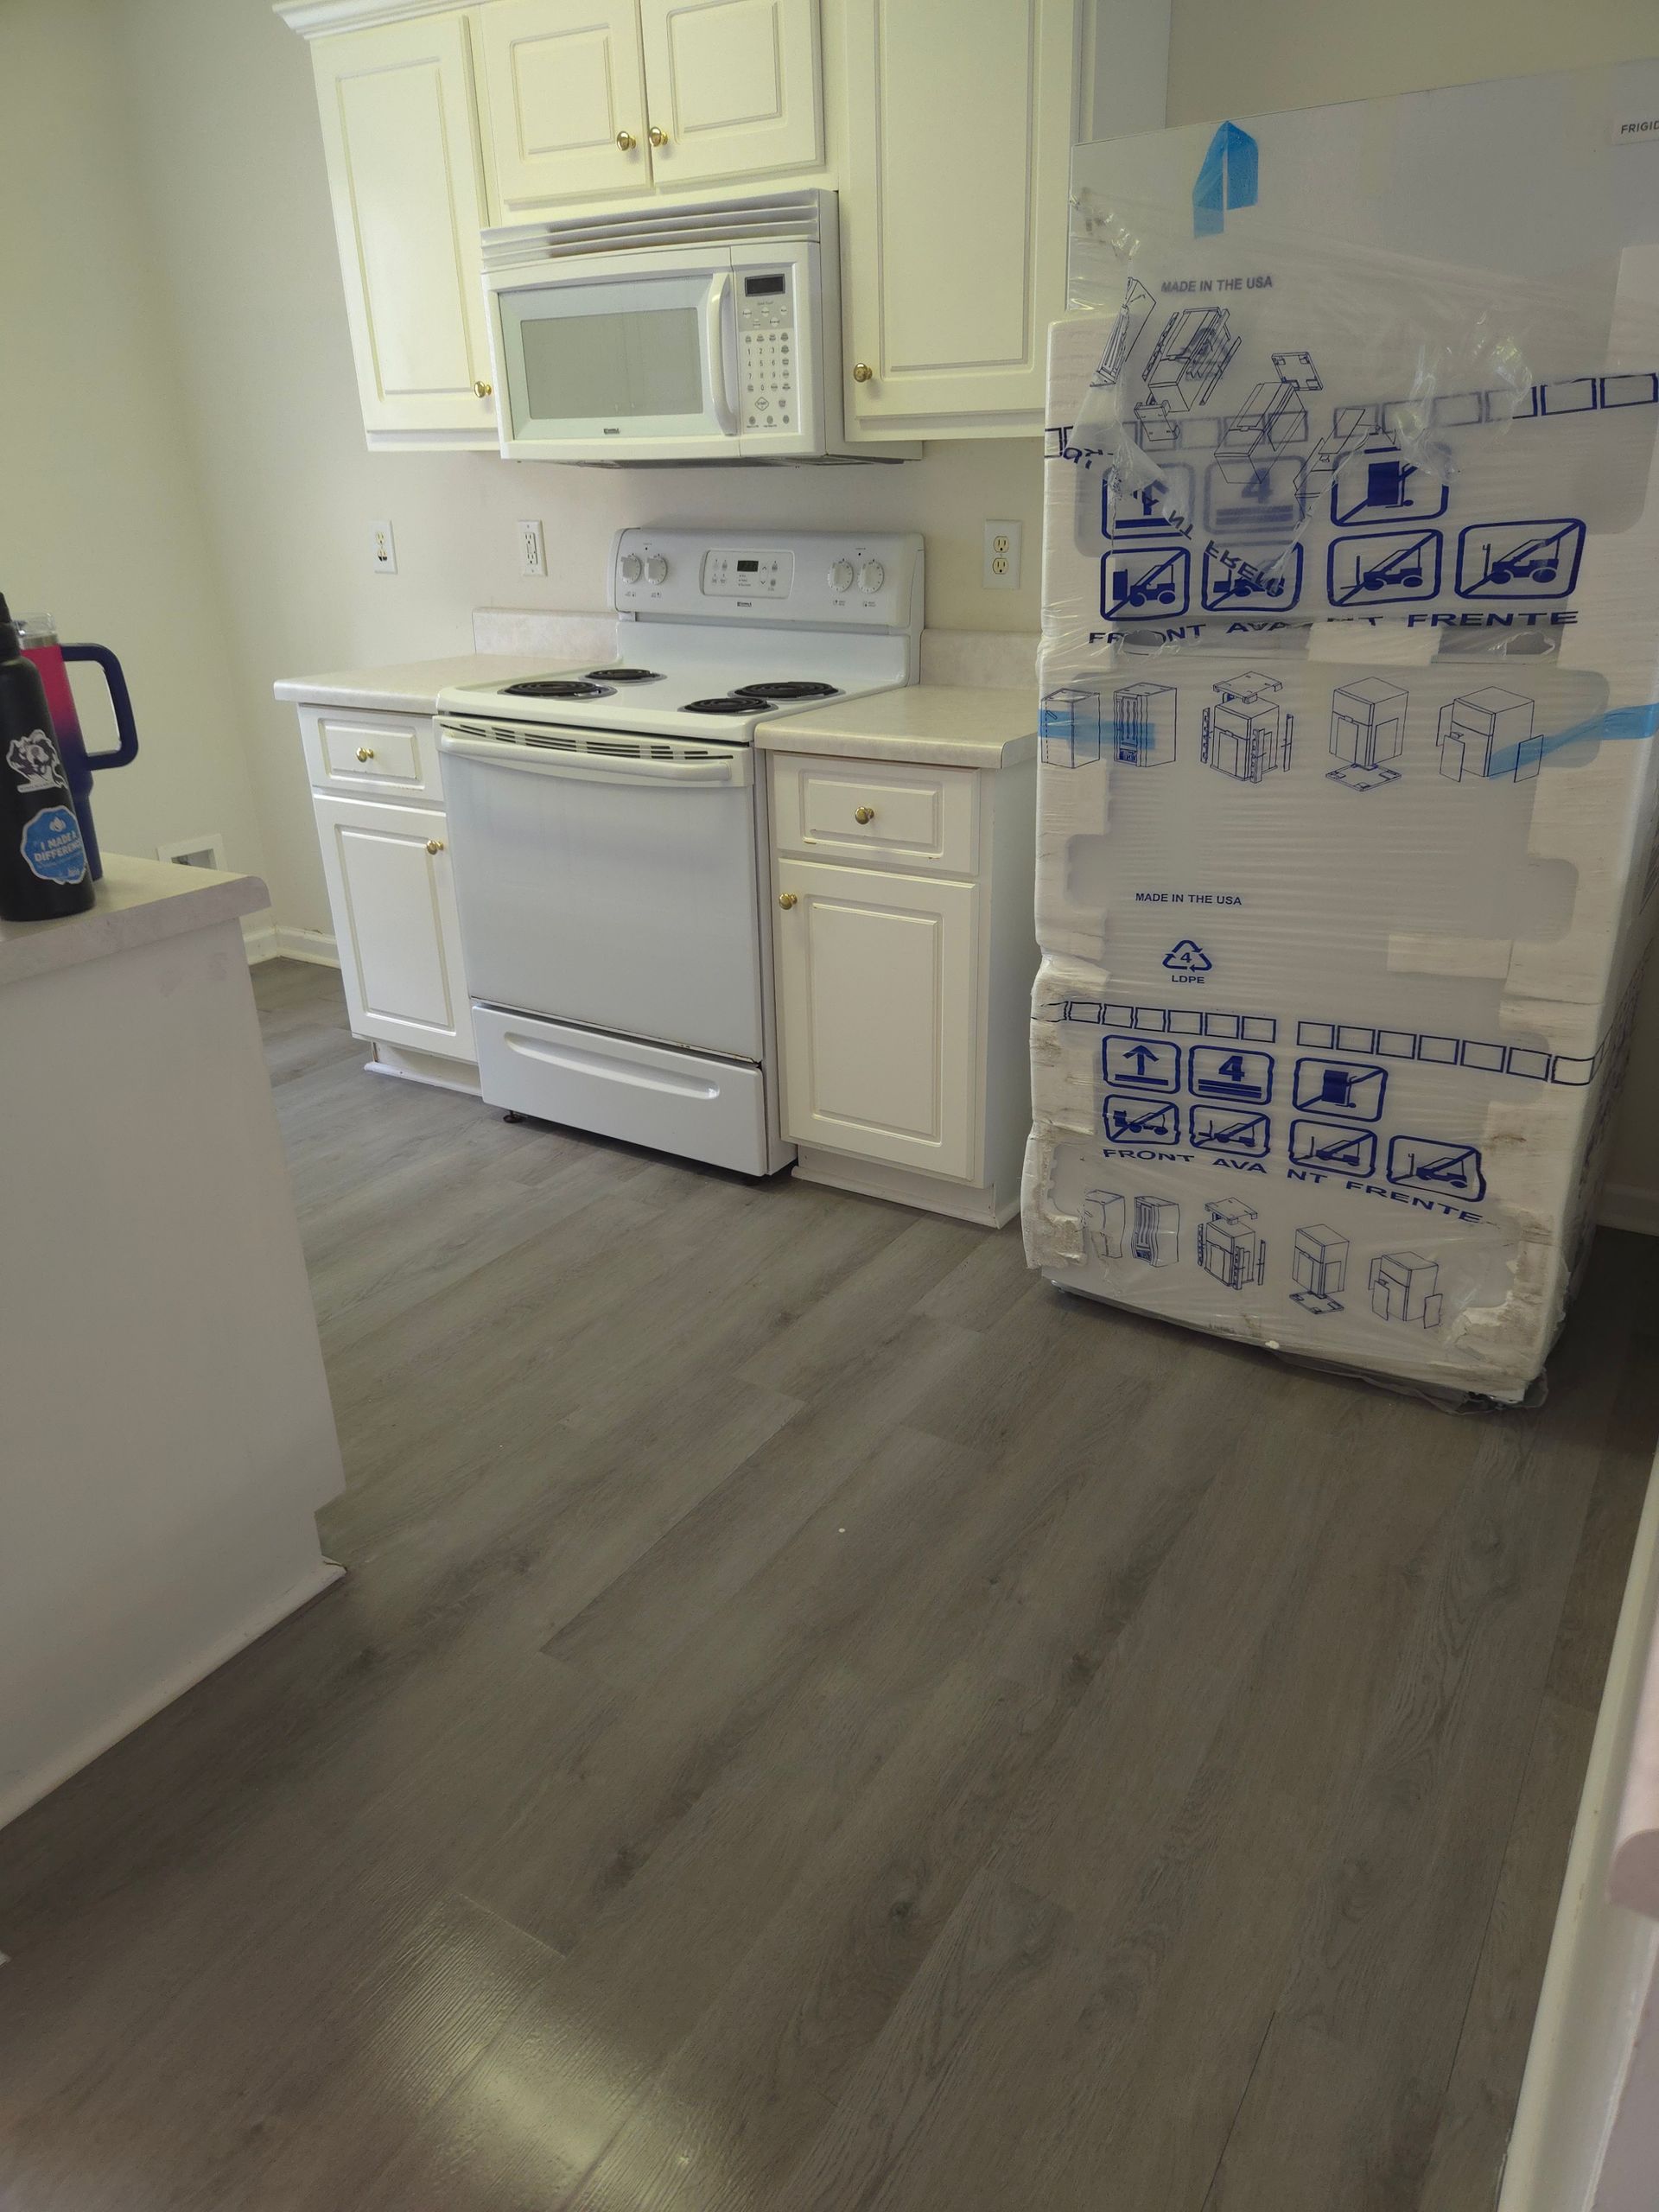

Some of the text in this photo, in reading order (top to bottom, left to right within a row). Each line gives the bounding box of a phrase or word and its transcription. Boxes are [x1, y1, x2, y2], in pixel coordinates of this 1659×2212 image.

[1160, 276, 1273, 293] MADE IN THE USA
[1242, 468, 1273, 504] 4
[1407, 611, 1579, 627] FRENTE
[1135, 893, 1243, 906] MADE IN THE USA
[1180, 952, 1192, 963] 4
[1171, 975, 1205, 984] LDPE
[1218, 1054, 1246, 1082] 4
[1103, 1148, 1195, 1162] FRONT
[1345, 1180, 1484, 1224] FRENTE
